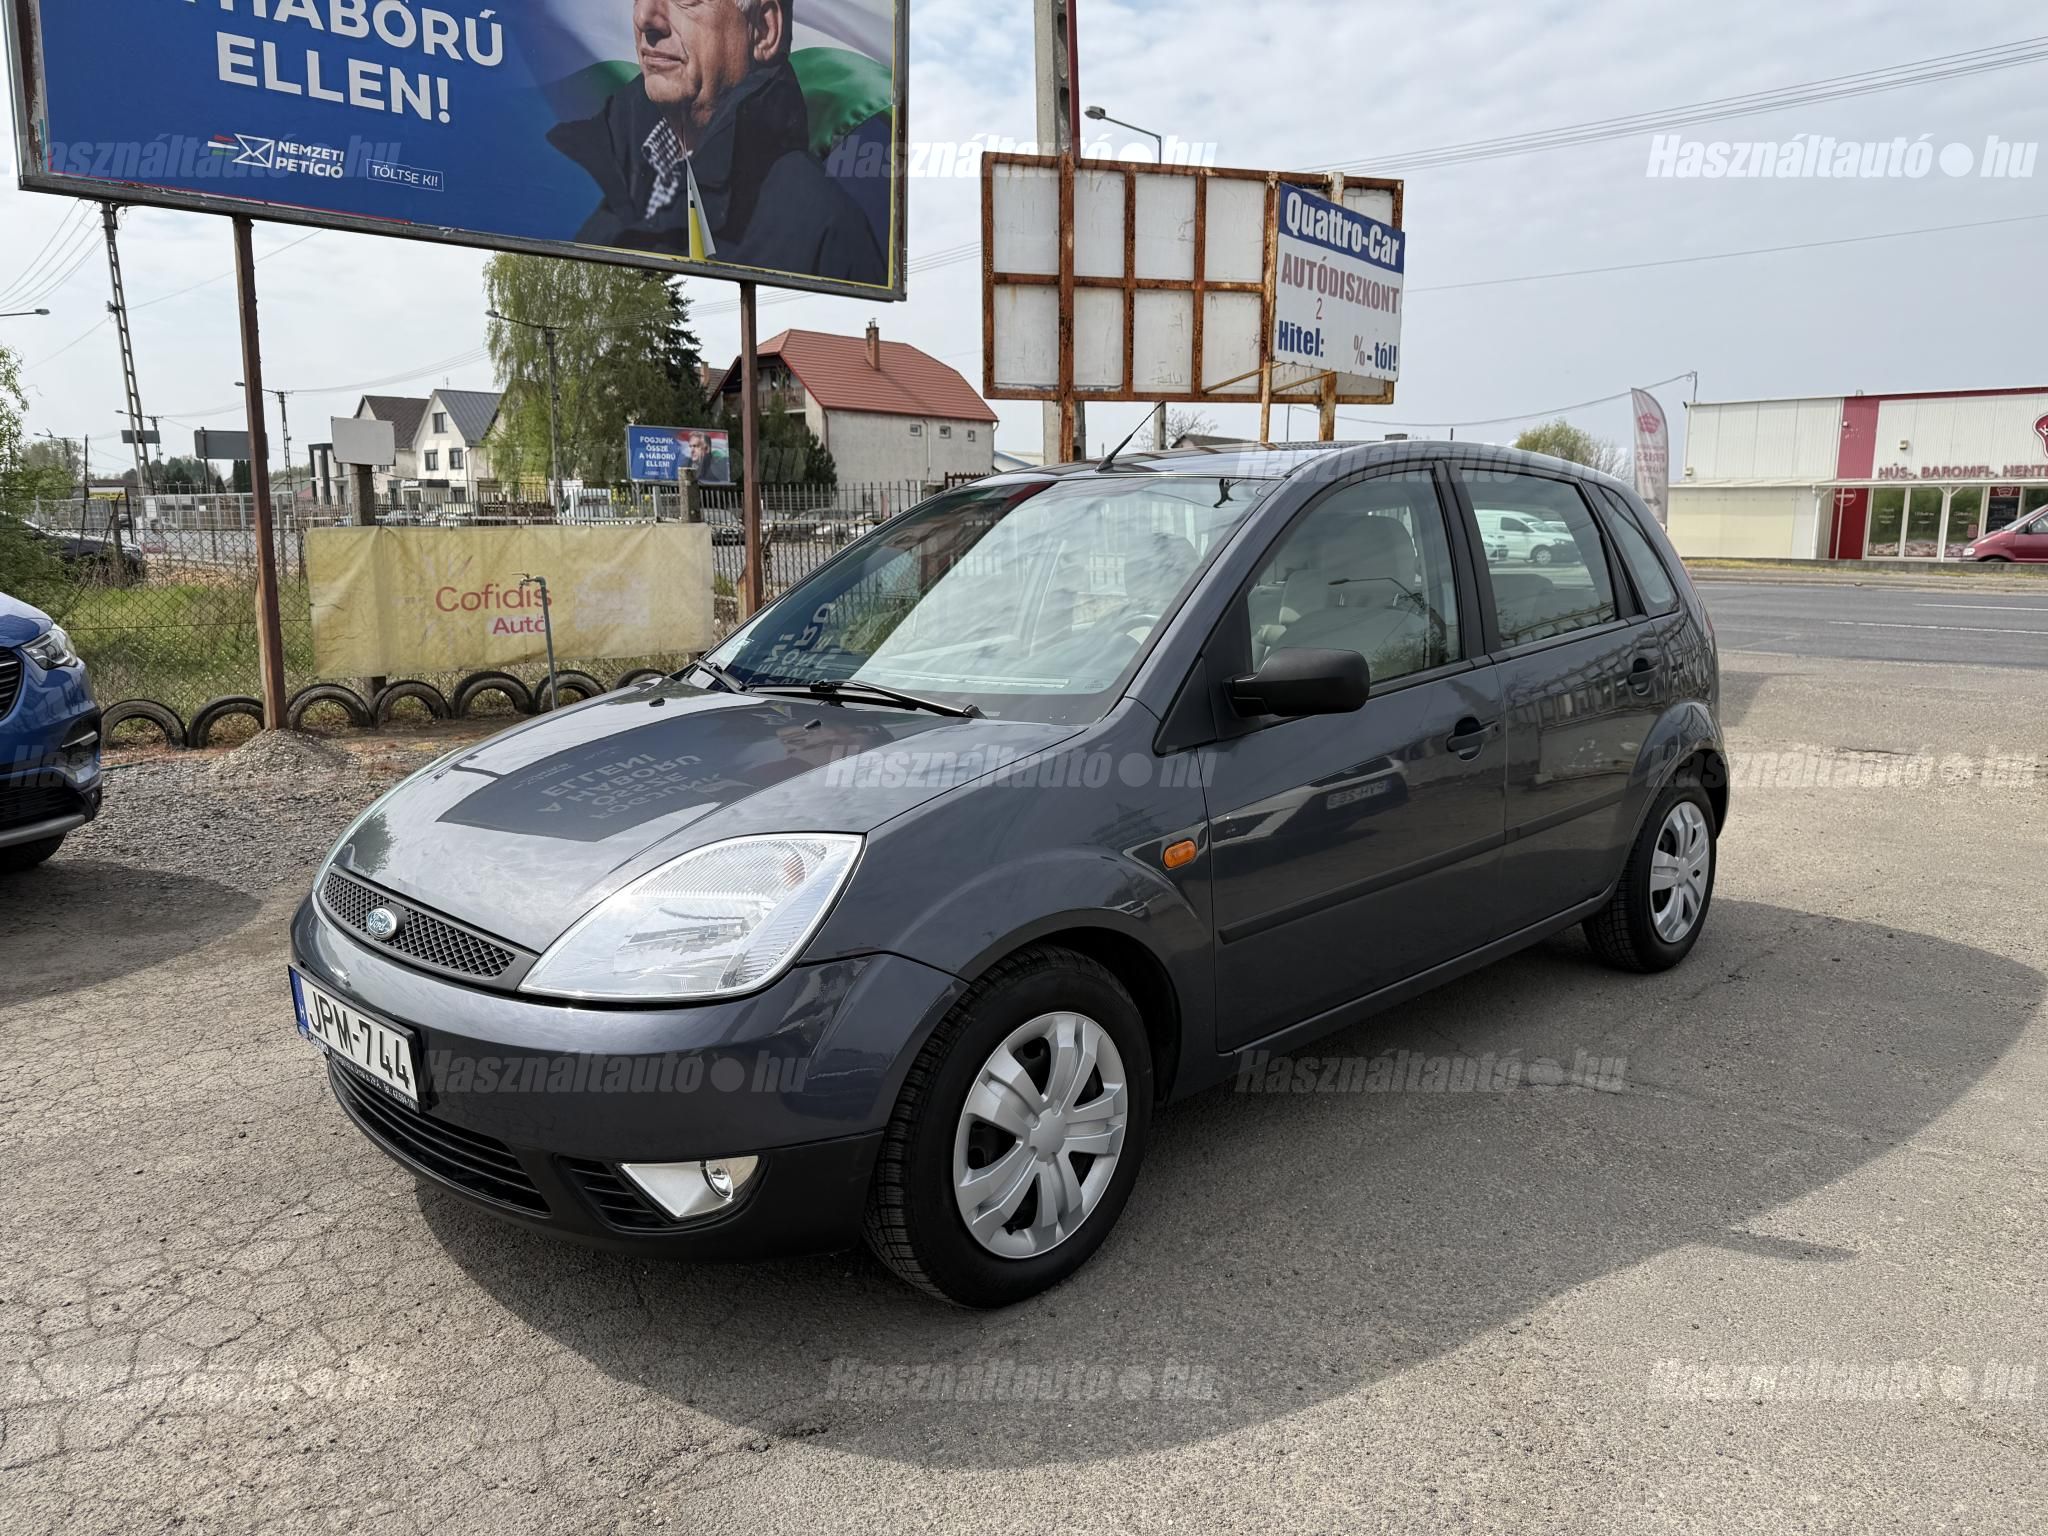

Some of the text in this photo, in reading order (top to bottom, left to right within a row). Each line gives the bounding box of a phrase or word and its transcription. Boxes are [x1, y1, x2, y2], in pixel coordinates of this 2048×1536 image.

[216, 31, 450, 124] ELLEN!
[277, 141, 344, 162] NEMZETI
[275, 156, 344, 179] PETÍCIÓ
[371, 164, 438, 187] TÖLTSE KI!
[1286, 191, 1400, 267] Quattro-Car
[1280, 252, 1400, 315] AUTÓDISZKONT
[1315, 297, 1323, 321] 2
[1278, 320, 1324, 358] Hitel:
[640, 436, 674, 445] FOGJUNK
[435, 583, 552, 612] Cofidis
[309, 990, 409, 1090] JPM-744
